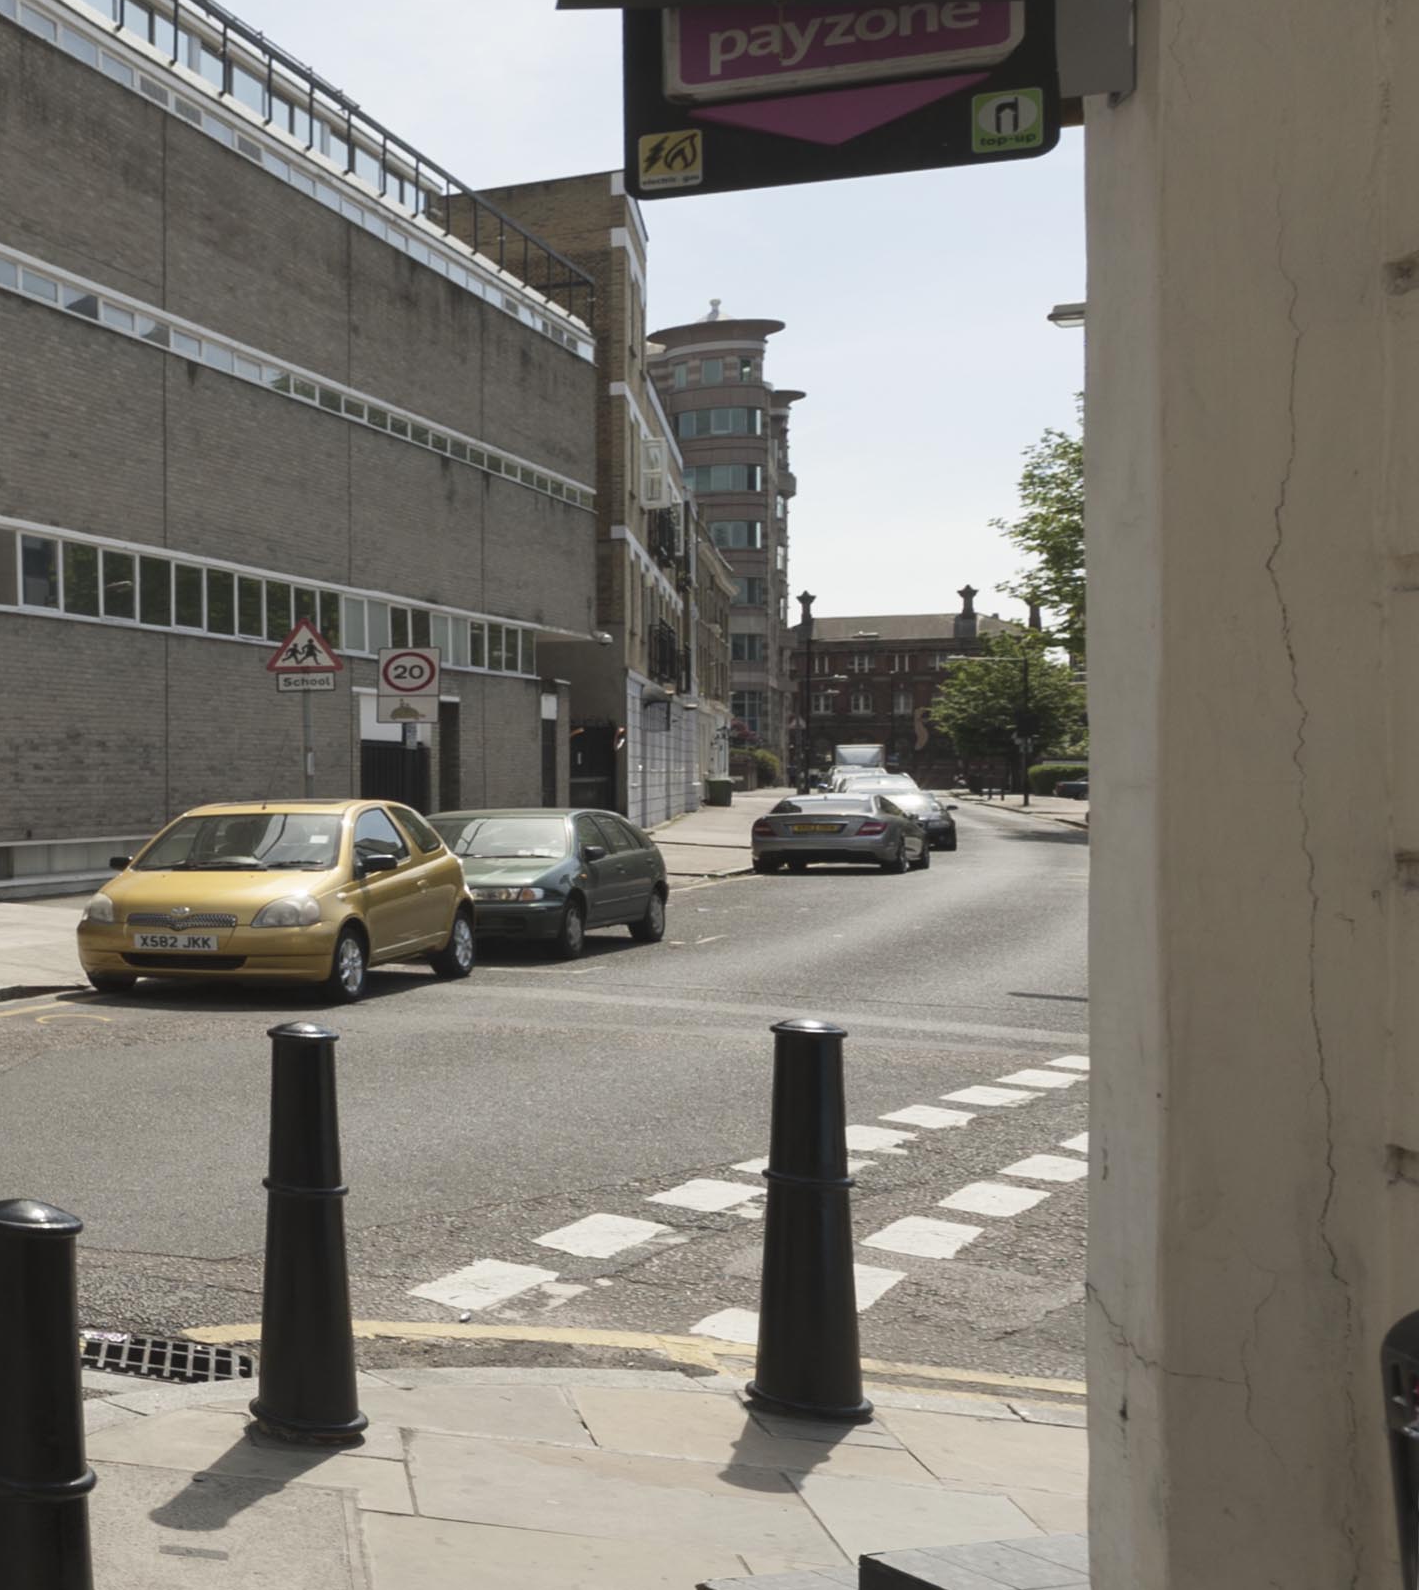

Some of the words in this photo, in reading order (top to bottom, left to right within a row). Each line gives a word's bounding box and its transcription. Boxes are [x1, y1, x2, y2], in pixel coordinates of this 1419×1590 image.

[709, 0, 982, 76] payzone
[980, 133, 1036, 147] top-up
[393, 665, 424, 680] 20
[282, 676, 331, 688] School
[140, 935, 178, 947] X582
[183, 937, 212, 948] JKK
